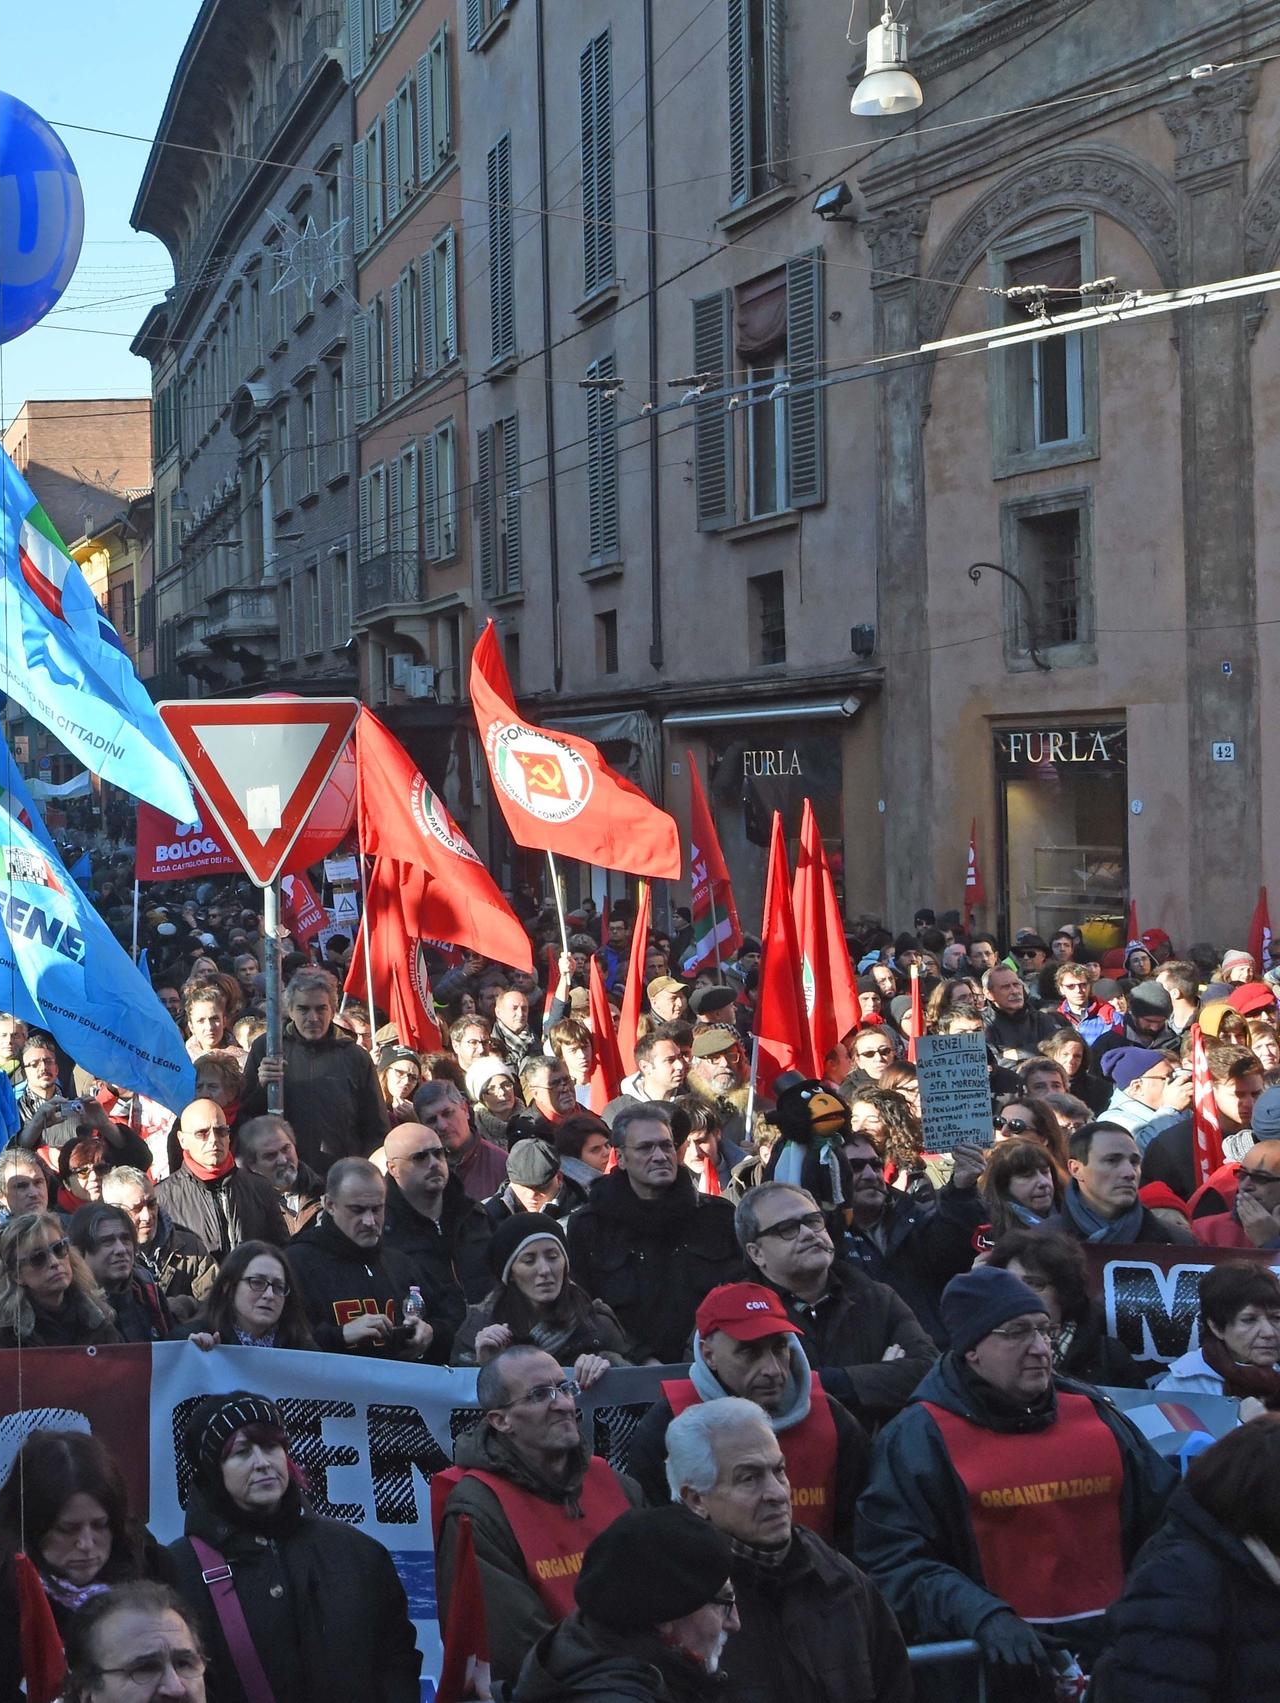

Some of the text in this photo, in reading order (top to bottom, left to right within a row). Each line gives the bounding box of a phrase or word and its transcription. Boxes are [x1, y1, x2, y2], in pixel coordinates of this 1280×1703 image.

[38, 699, 55, 721] DEI
[56, 714, 126, 761] CITTADINI
[1009, 730, 1111, 763] FURLA
[1216, 745, 1232, 759] 42
[743, 750, 803, 776] FURLA
[428, 816, 455, 848] PARTITO
[152, 864, 171, 873] LEGA
[78, 1016, 102, 1033] EDILI
[102, 1026, 128, 1049] AFFINI
[152, 1056, 183, 1074] LEGNO
[932, 1037, 961, 1053] RENZI
[923, 1070, 942, 1079] CHE
[930, 1081, 947, 1090] STA
[745, 1300, 770, 1311] CGIL
[980, 1475, 1113, 1508] ORGANIZZAZIONE
